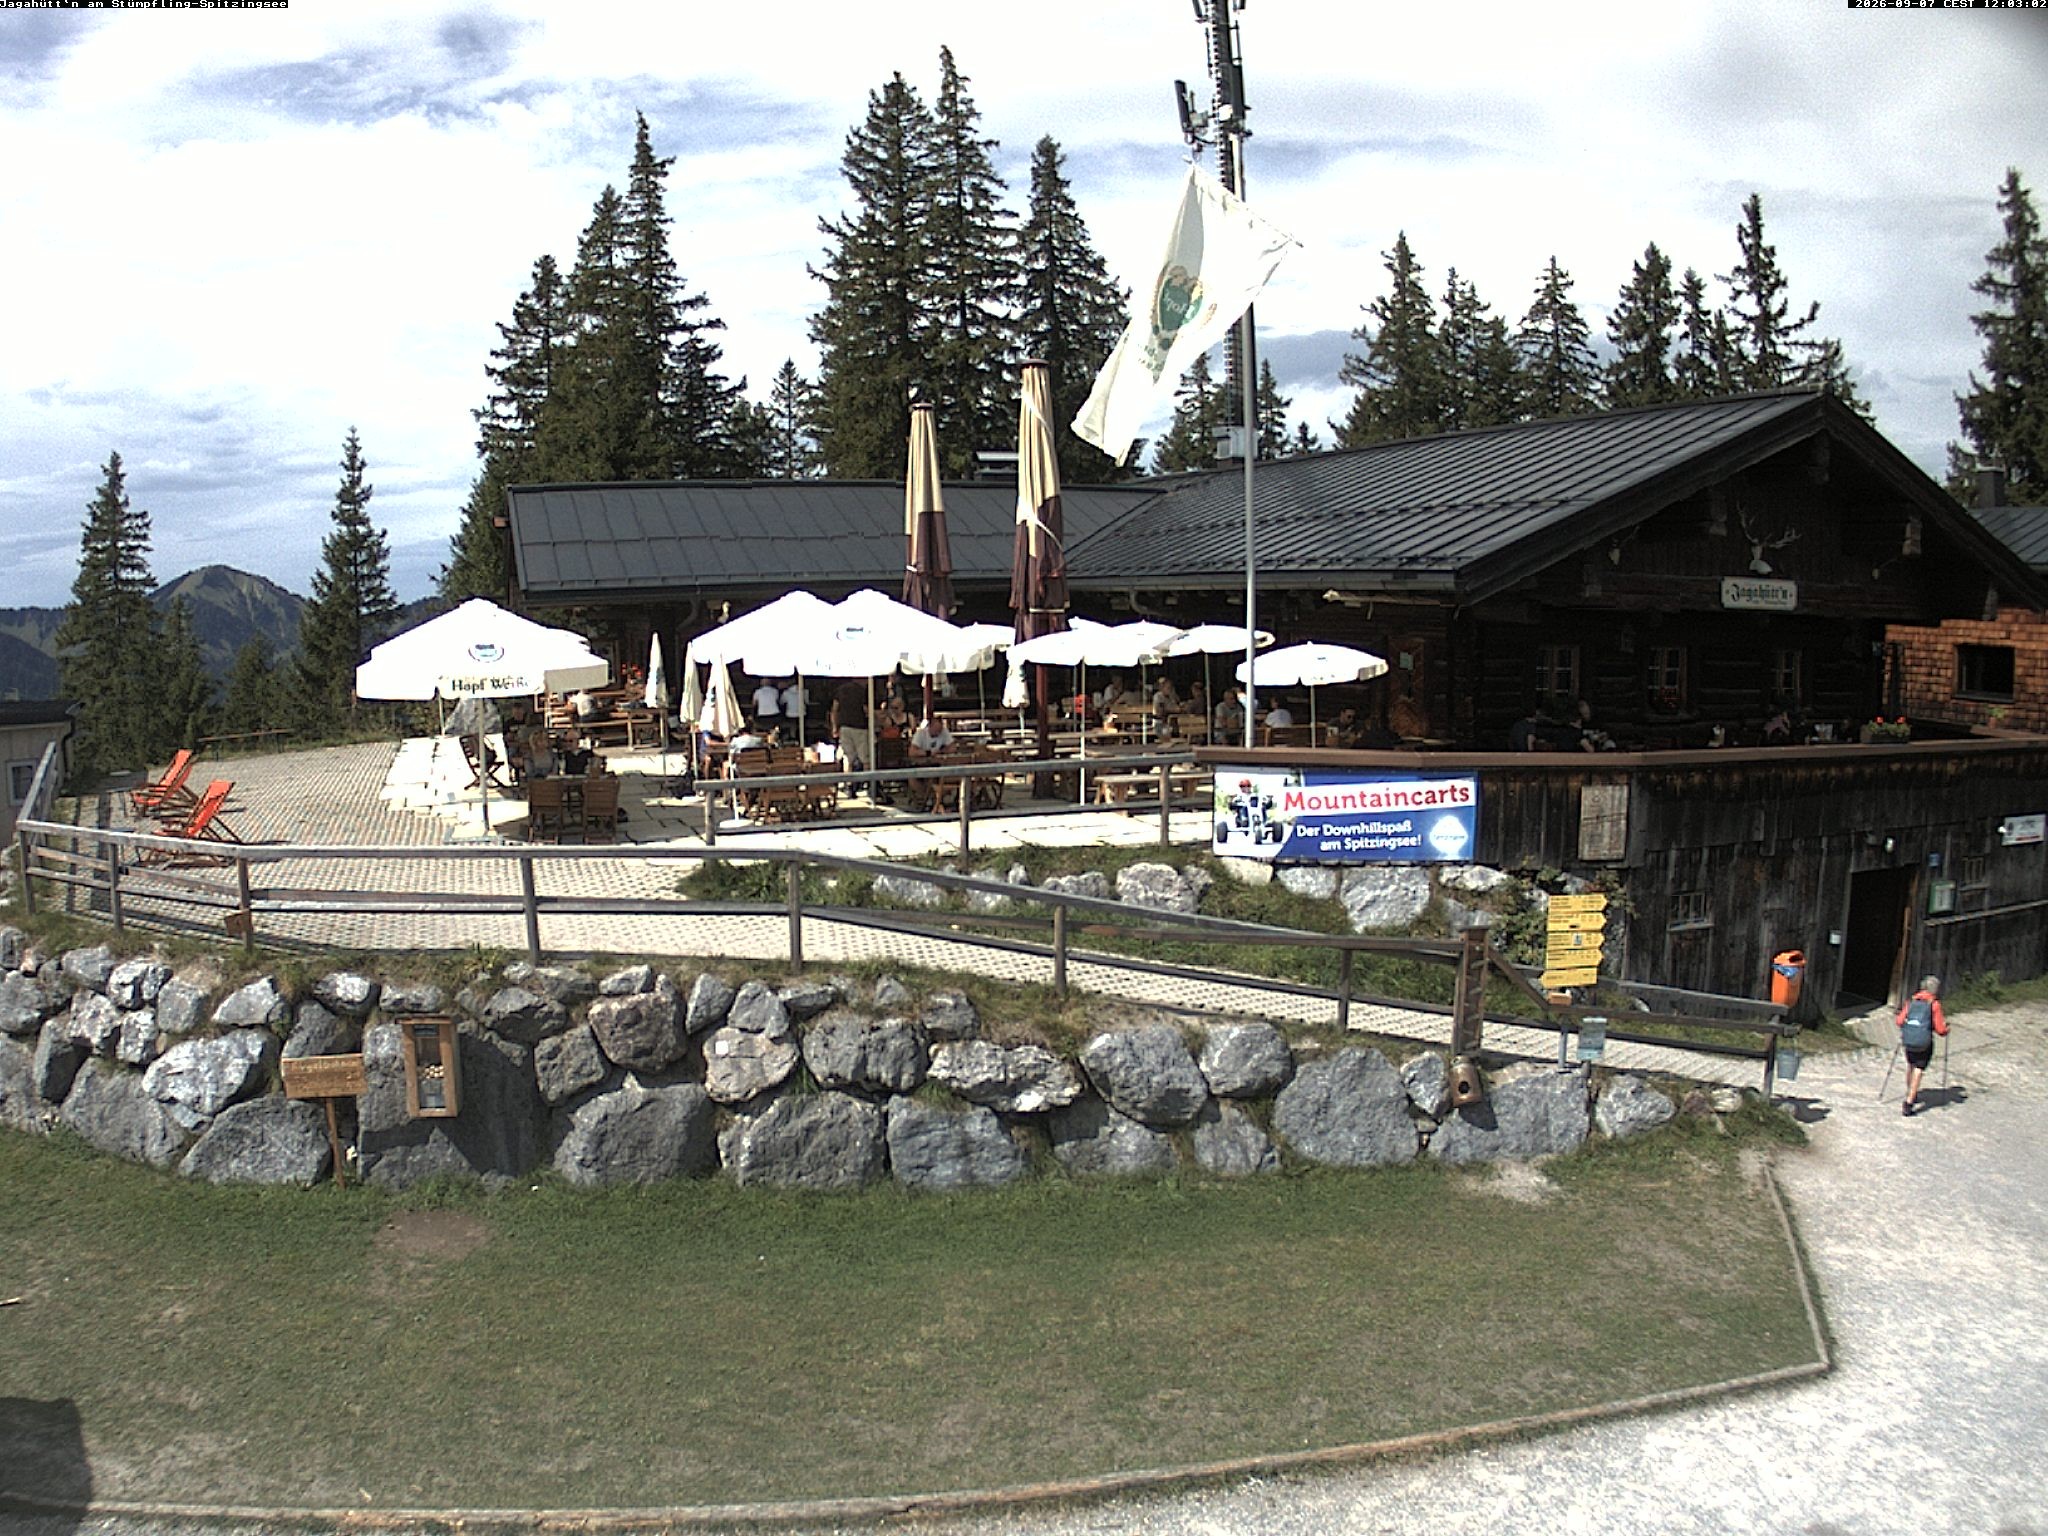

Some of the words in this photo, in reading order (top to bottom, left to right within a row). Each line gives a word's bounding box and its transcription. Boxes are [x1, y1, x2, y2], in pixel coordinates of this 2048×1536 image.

[1284, 784, 1470, 812] Mountaincarts
[1297, 824, 1320, 837] Der
[1323, 820, 1412, 838] Downhillspaß
[1320, 840, 1341, 851] am
[1344, 835, 1421, 853] Spitzingsee!
